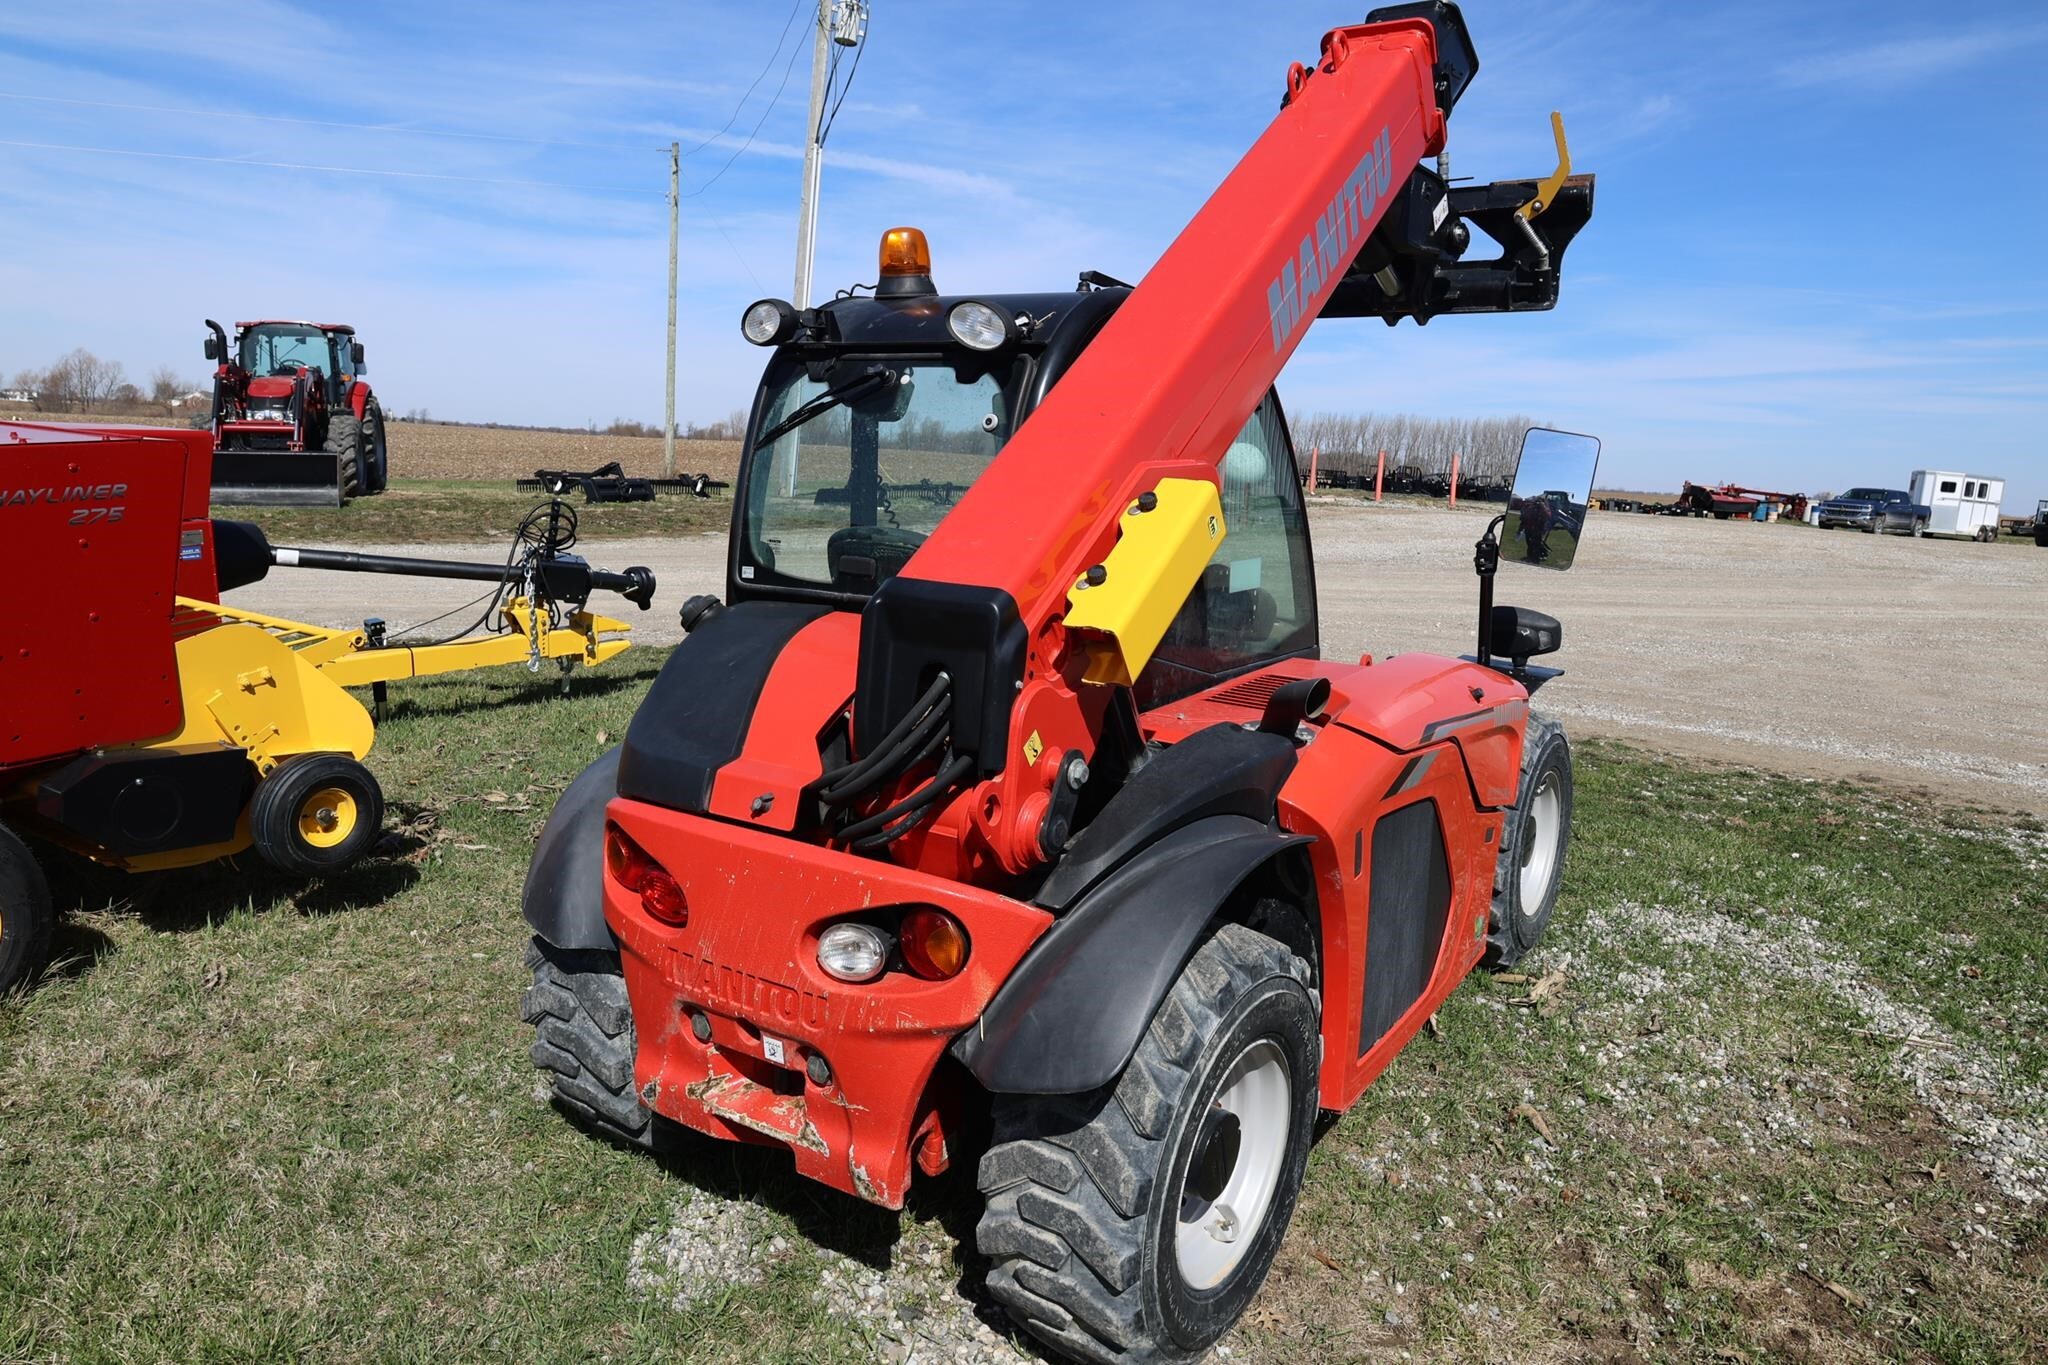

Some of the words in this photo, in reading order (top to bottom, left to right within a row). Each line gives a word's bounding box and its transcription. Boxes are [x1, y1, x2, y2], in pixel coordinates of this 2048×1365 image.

[1267, 125, 1392, 354] MANITOU
[68, 506, 126, 526] 275
[665, 947, 828, 1033] MANITOU
